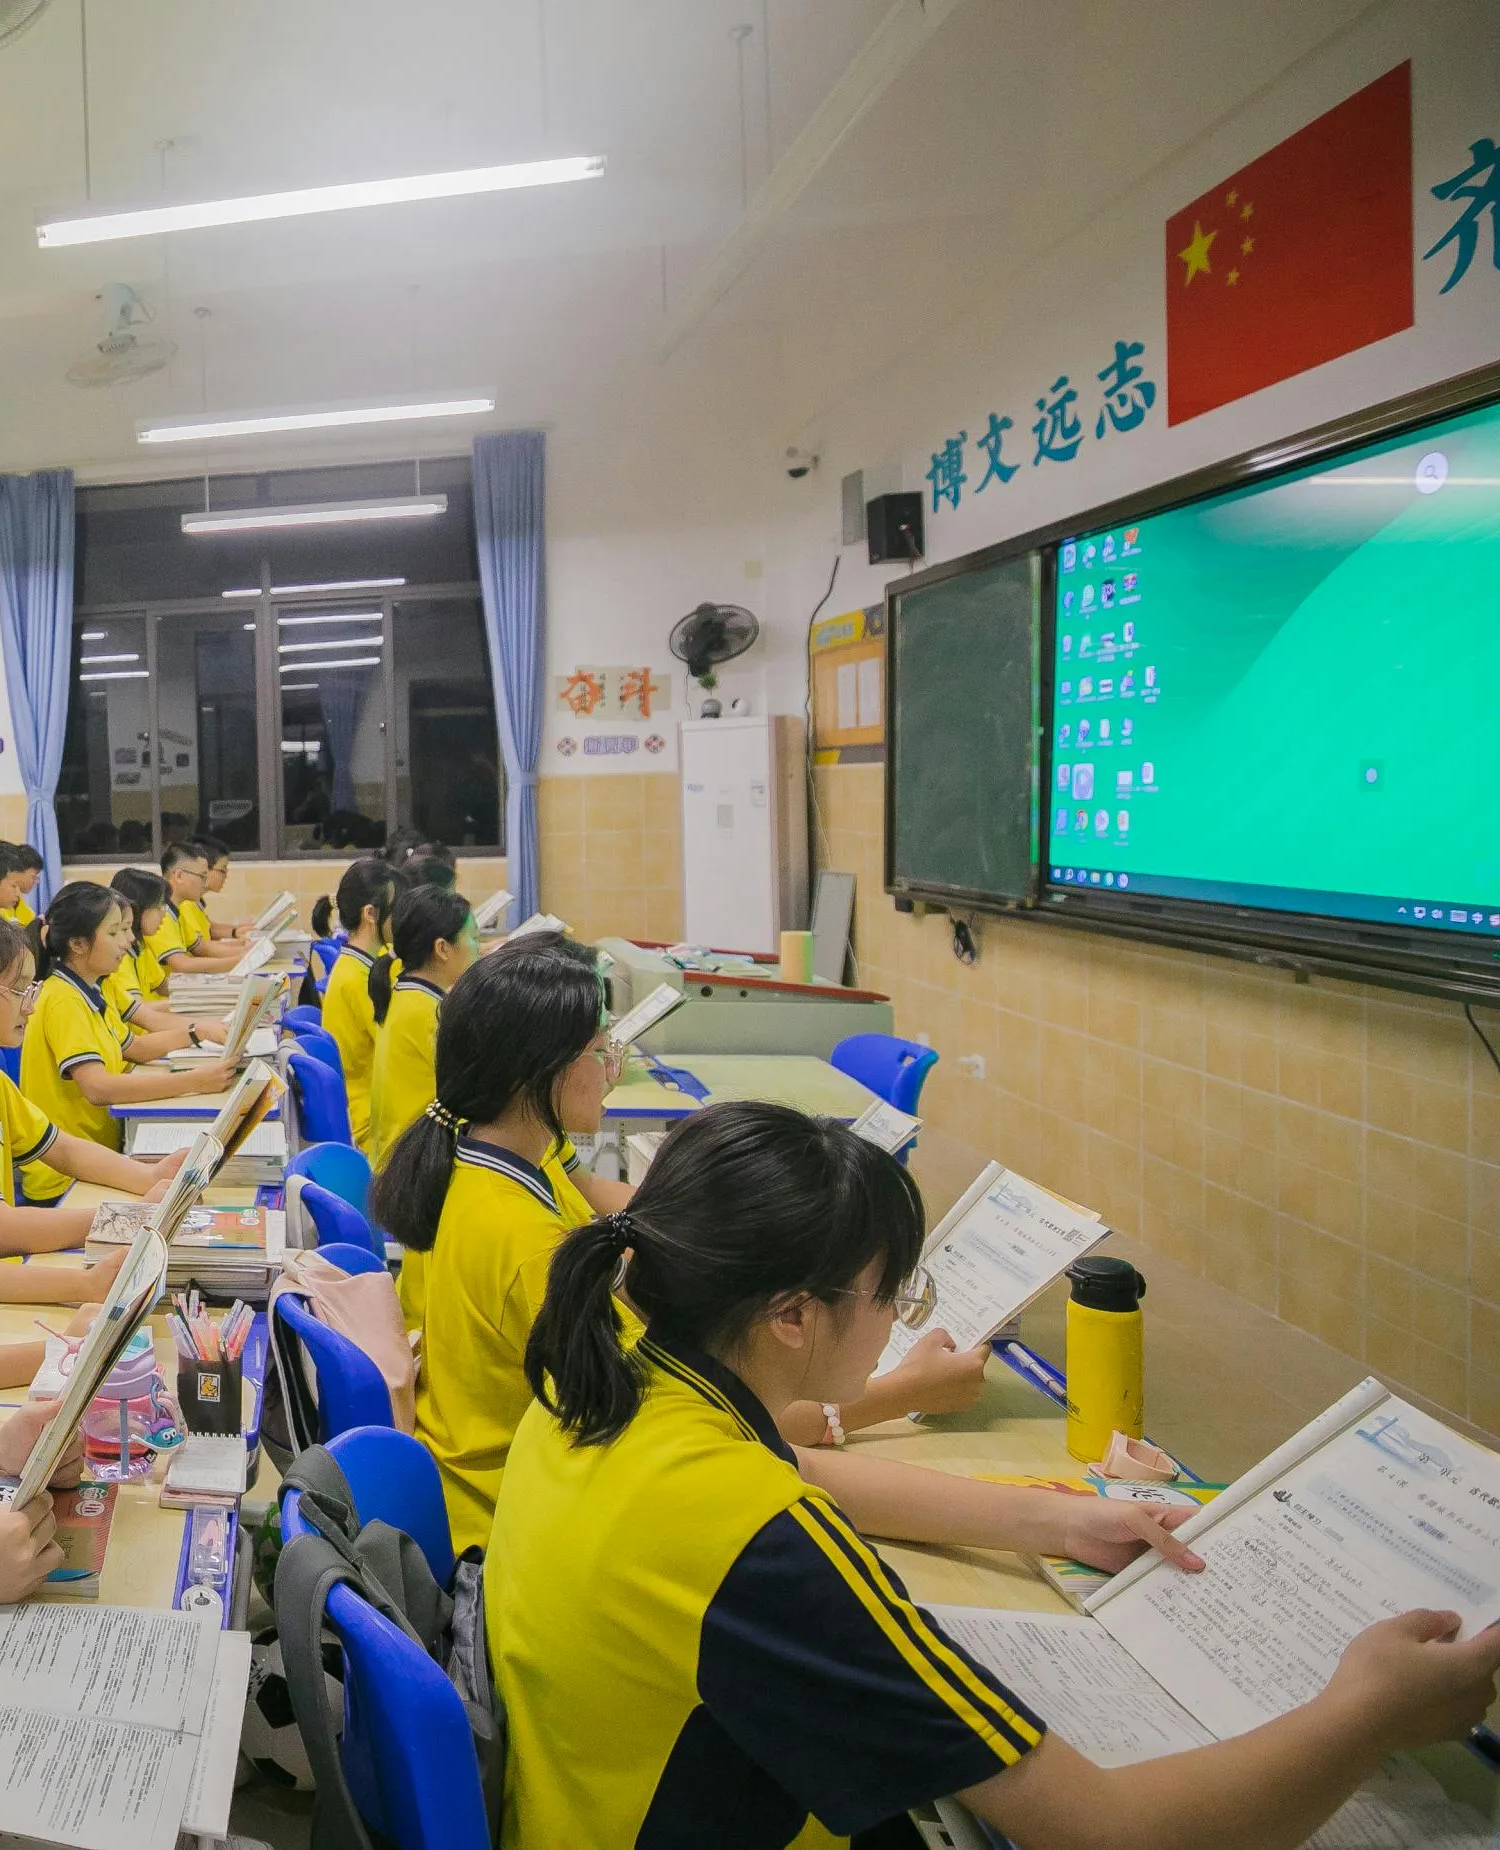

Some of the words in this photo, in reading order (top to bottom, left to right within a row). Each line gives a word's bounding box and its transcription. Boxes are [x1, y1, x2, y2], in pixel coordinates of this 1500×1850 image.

[926, 340, 1156, 513] 博文远志
[559, 667, 659, 720] 奋斗
